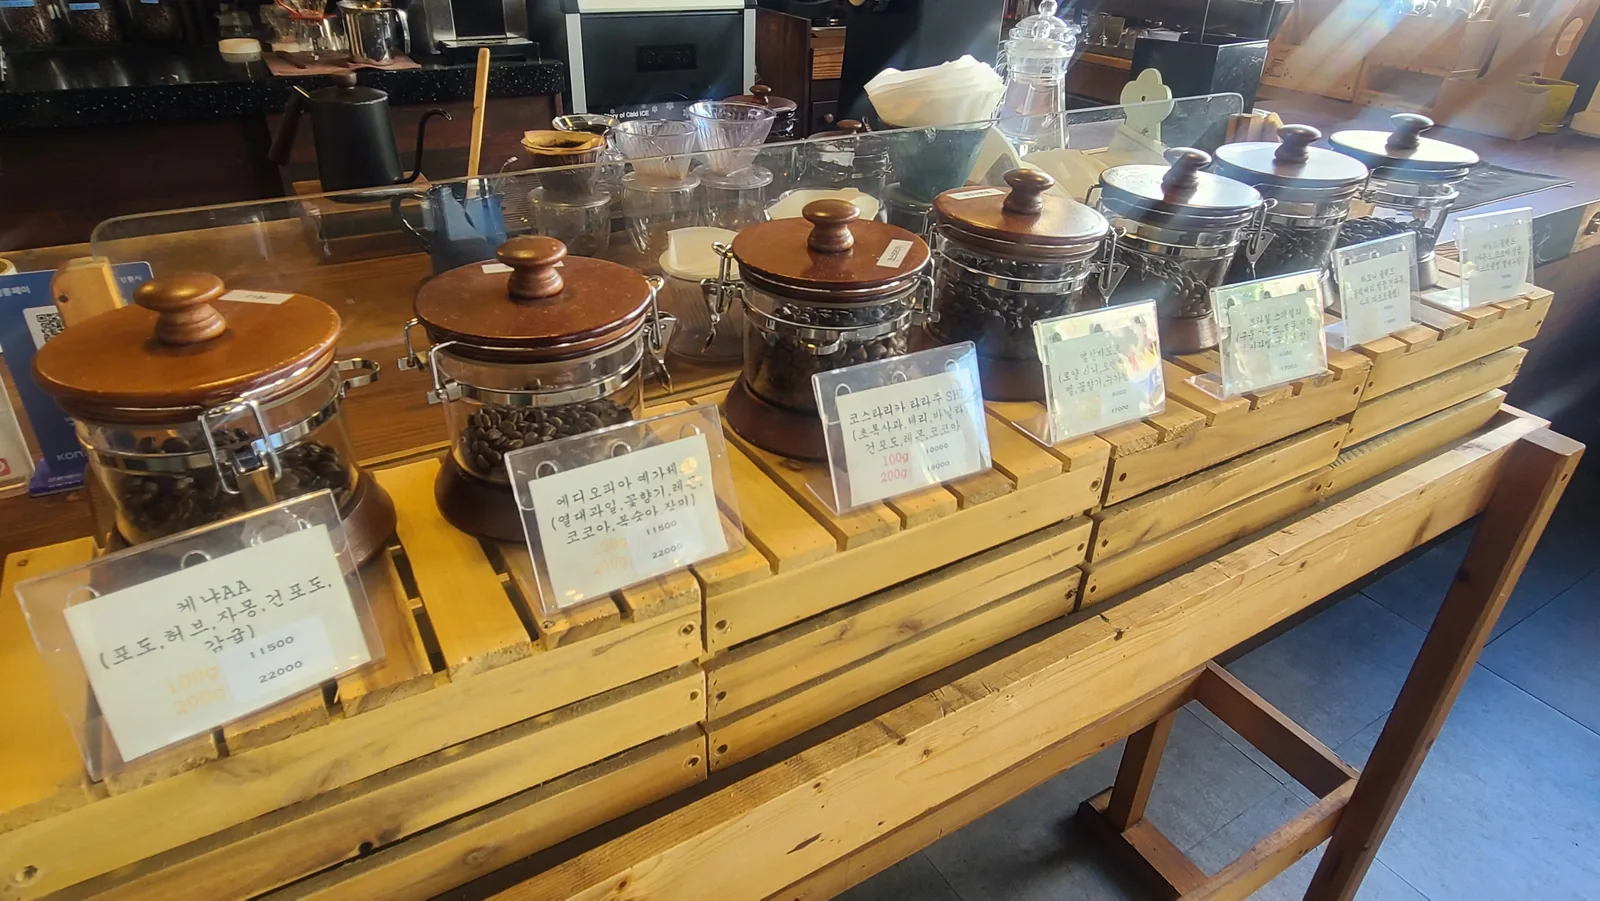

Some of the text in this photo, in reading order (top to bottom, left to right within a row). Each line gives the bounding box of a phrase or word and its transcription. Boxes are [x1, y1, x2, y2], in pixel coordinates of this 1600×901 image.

[1080, 344, 1121, 363] 엘살바도르
[849, 388, 966, 425] 코스타리카 타라주 SH
[638, 457, 697, 483] 예가체
[883, 452, 909, 467] 100g
[881, 468, 908, 483] 200g
[646, 520, 677, 535] 11500
[652, 543, 682, 559] 22000
[176, 580, 252, 614] 케냐AA
[249, 636, 294, 659] 11500
[259, 660, 303, 684] 22000
